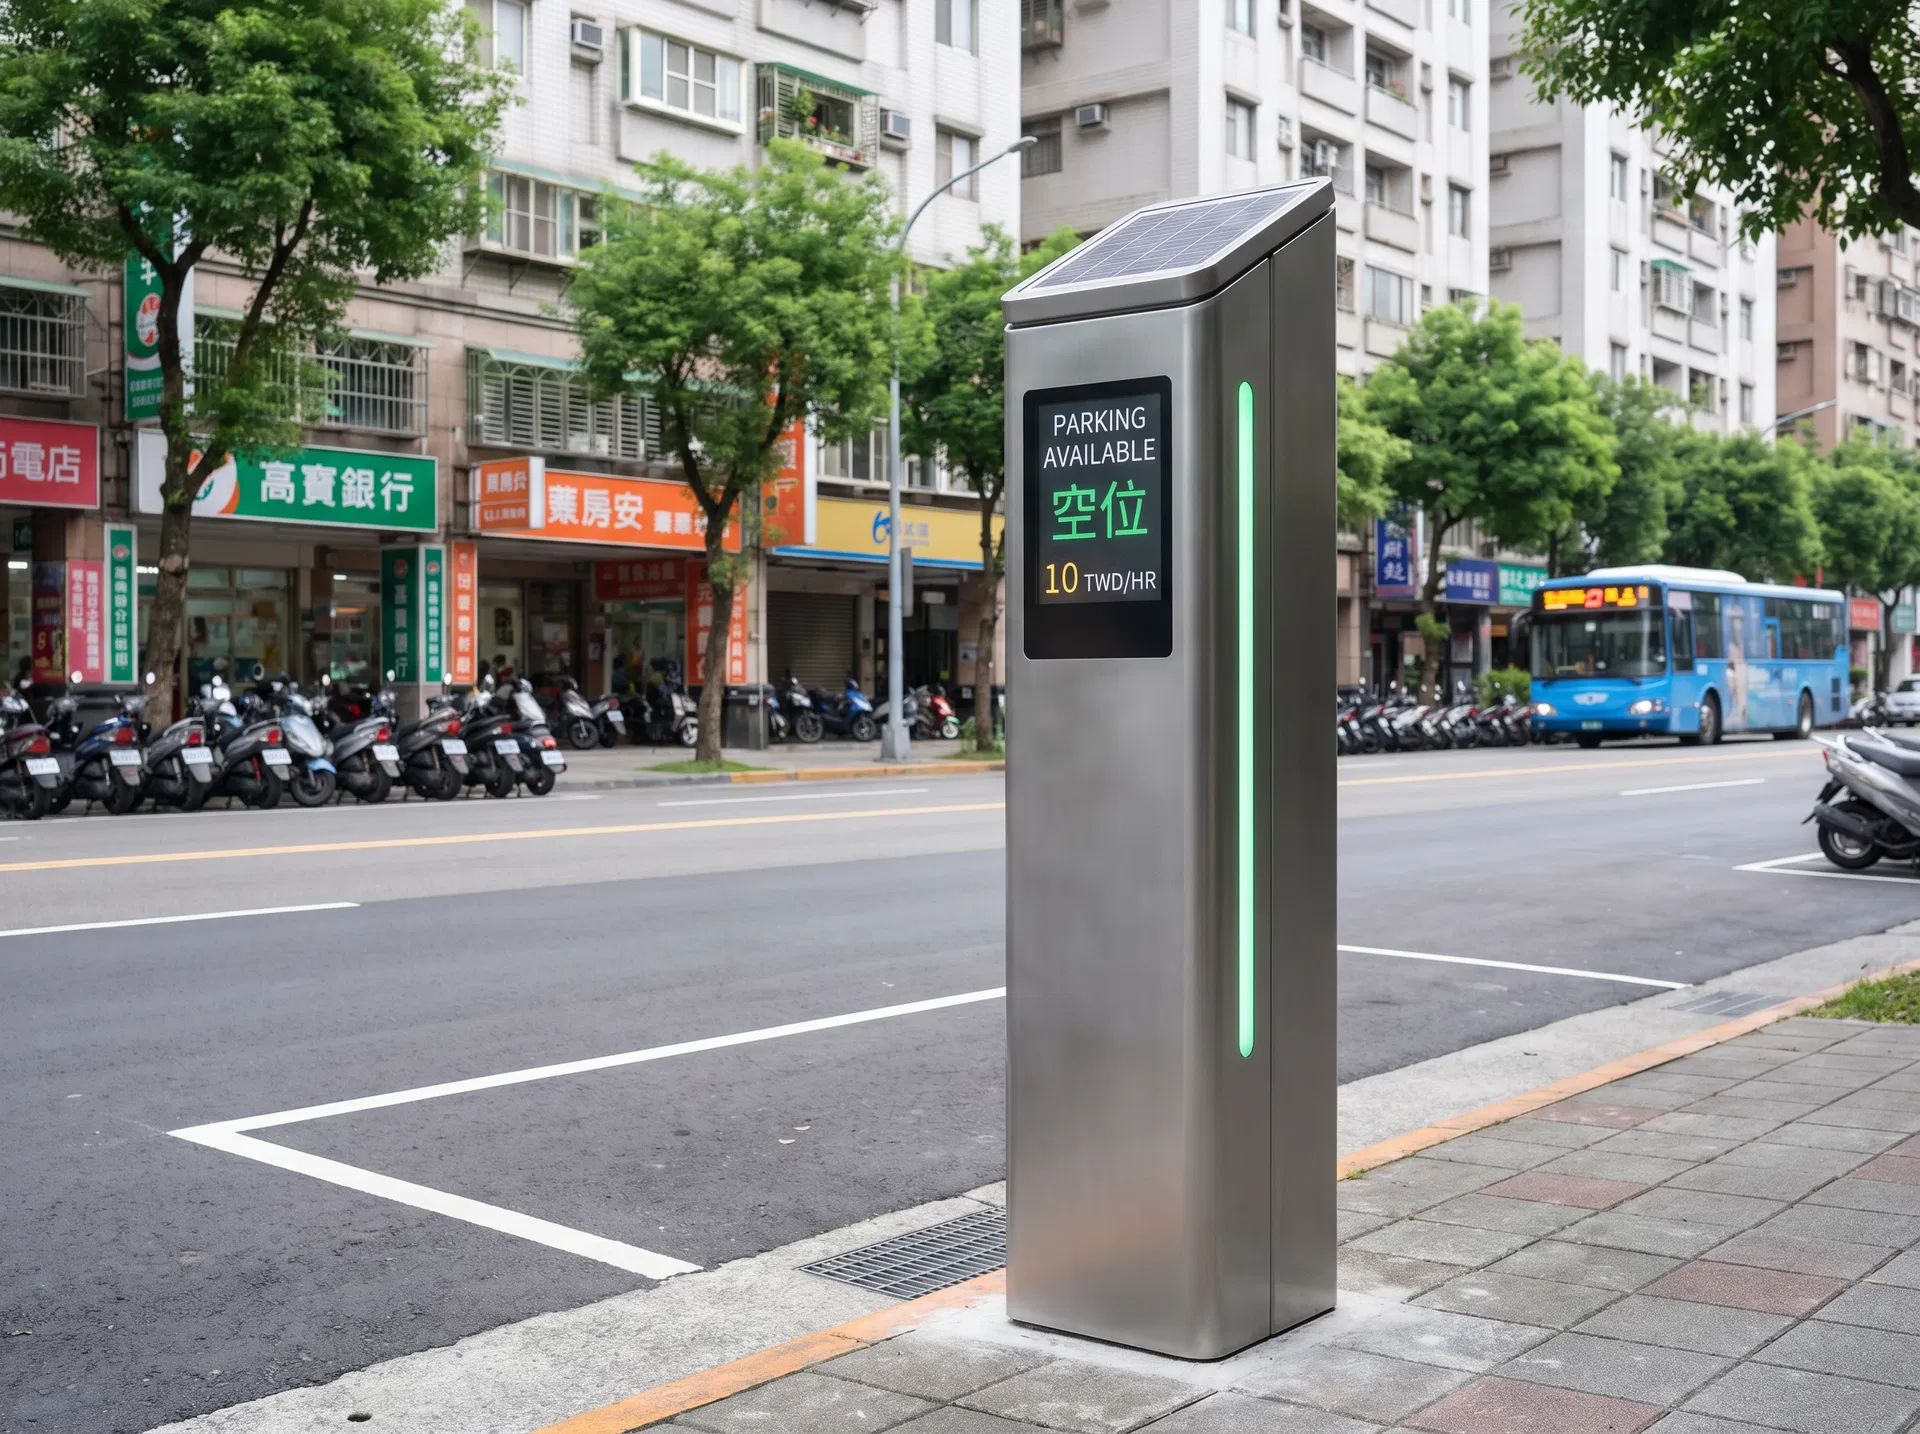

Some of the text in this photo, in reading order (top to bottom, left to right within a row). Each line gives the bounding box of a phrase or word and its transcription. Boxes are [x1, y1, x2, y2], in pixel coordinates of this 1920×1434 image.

[1054, 406, 1146, 437] PARKING
[1043, 437, 1156, 469] AVAILABLE
[1052, 479, 1148, 541] 空位
[1045, 562, 1156, 595] 10 TWD/HR
